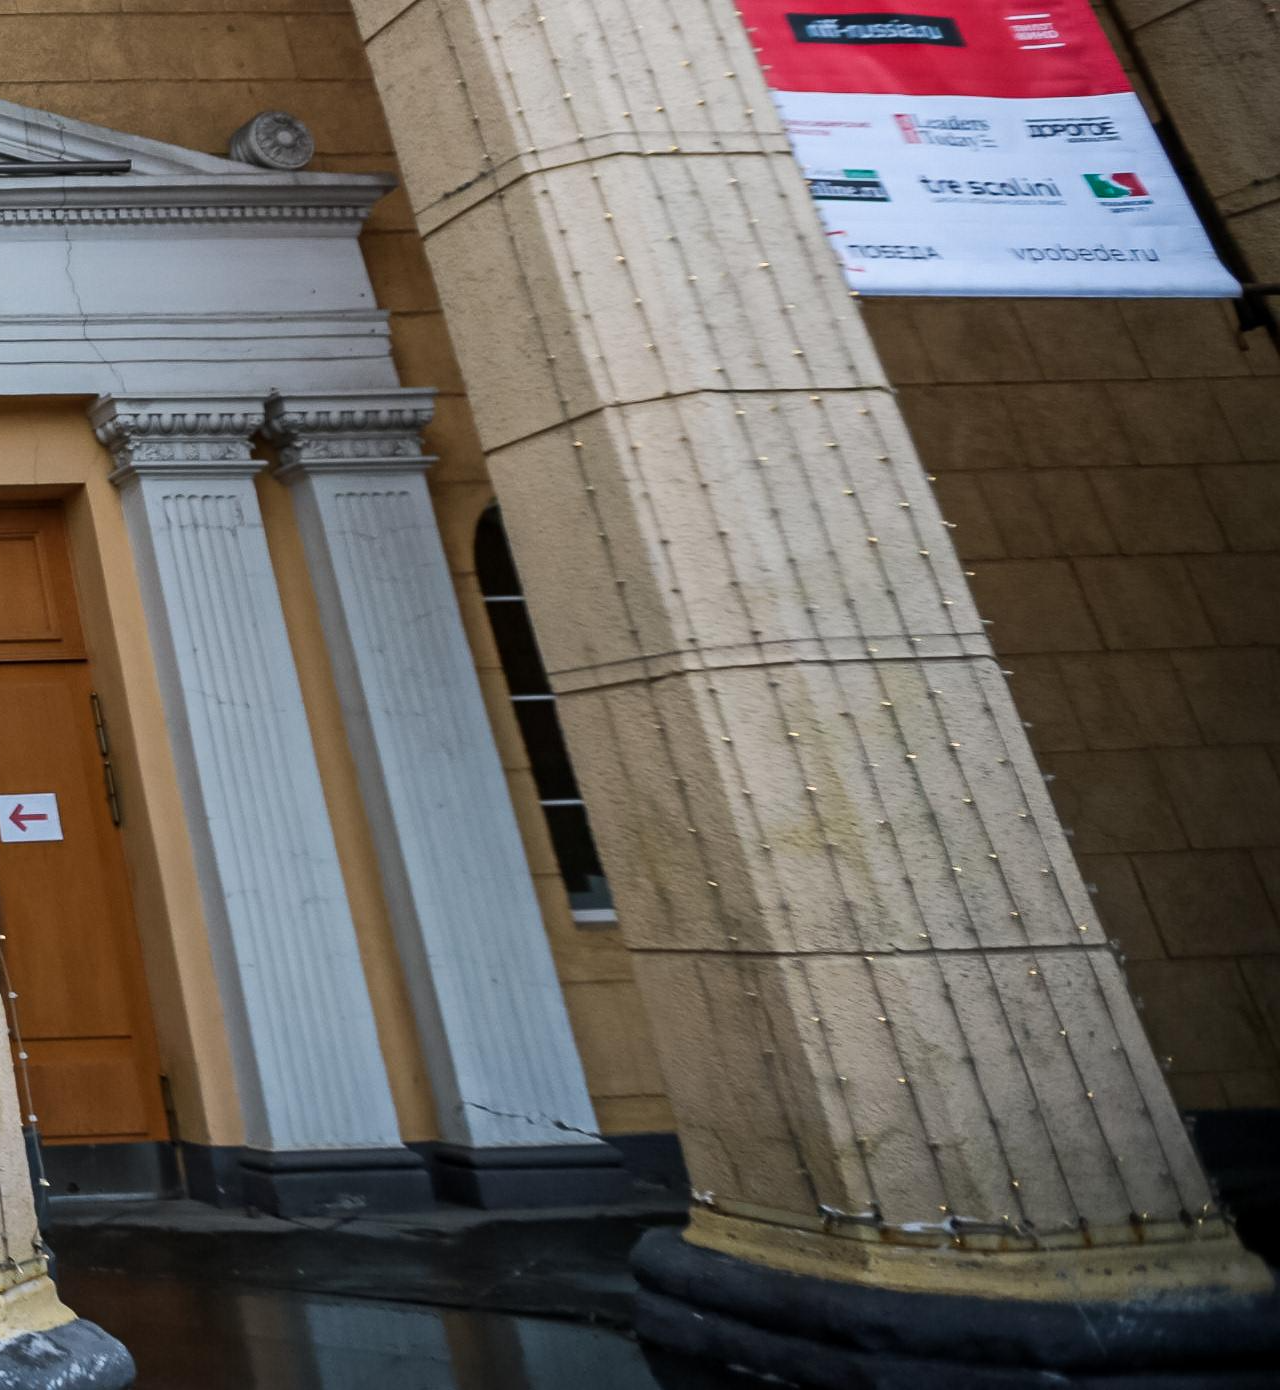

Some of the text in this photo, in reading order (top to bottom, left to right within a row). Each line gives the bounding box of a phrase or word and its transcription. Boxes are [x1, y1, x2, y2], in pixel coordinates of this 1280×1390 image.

[1027, 121, 1120, 137] ДОРОГОЕ
[919, 176, 1063, 197] tre scolini
[847, 244, 945, 260] ПОБЕДА
[1011, 243, 1160, 264] vpobede.ru
